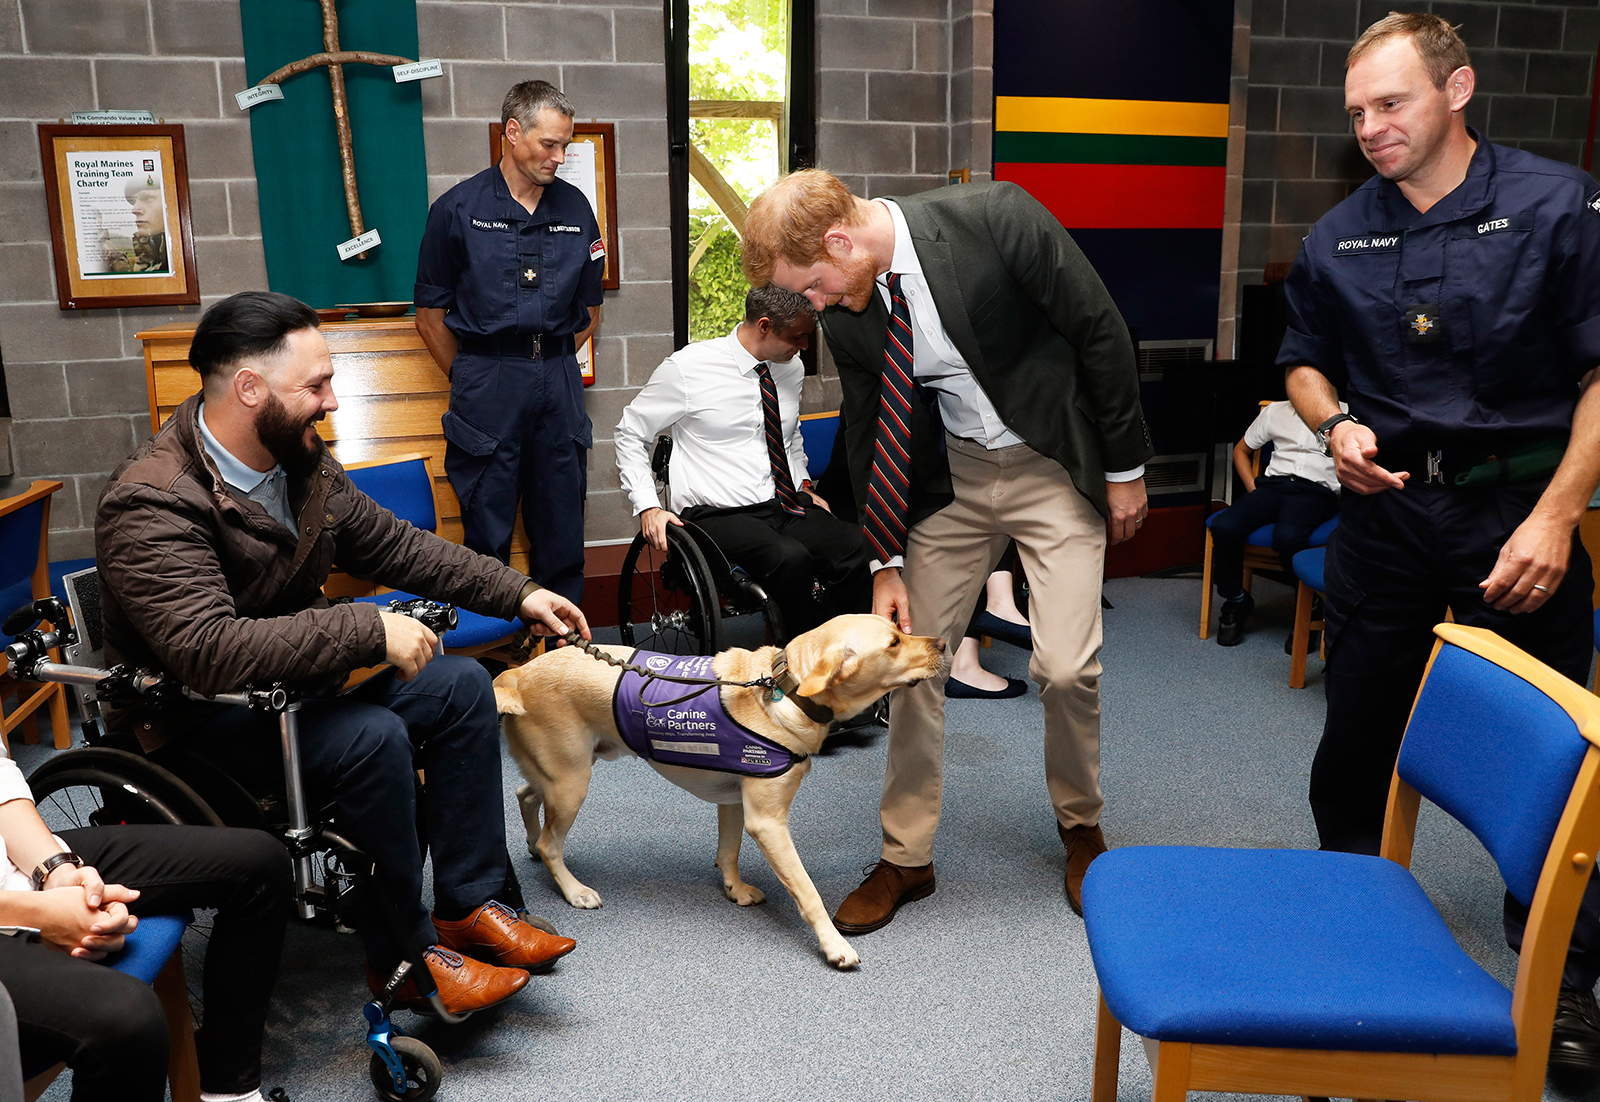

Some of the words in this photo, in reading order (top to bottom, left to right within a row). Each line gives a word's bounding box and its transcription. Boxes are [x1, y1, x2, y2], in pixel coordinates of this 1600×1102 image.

[397, 65, 438, 76] SELF-DISCIPLINE
[247, 90, 273, 100] INTEGRITY
[74, 160, 98, 169] Royal
[100, 160, 134, 168] Marines
[75, 170, 110, 179] Training
[472, 219, 492, 228] ROYAL
[492, 222, 509, 230] NAVY
[1477, 218, 1509, 234] GATES
[345, 237, 373, 252] EXCELLENCE
[1338, 239, 1369, 250] ROYAL
[1371, 237, 1399, 248] NAVY
[667, 709, 707, 720] Canine
[667, 720, 717, 731] Partners
